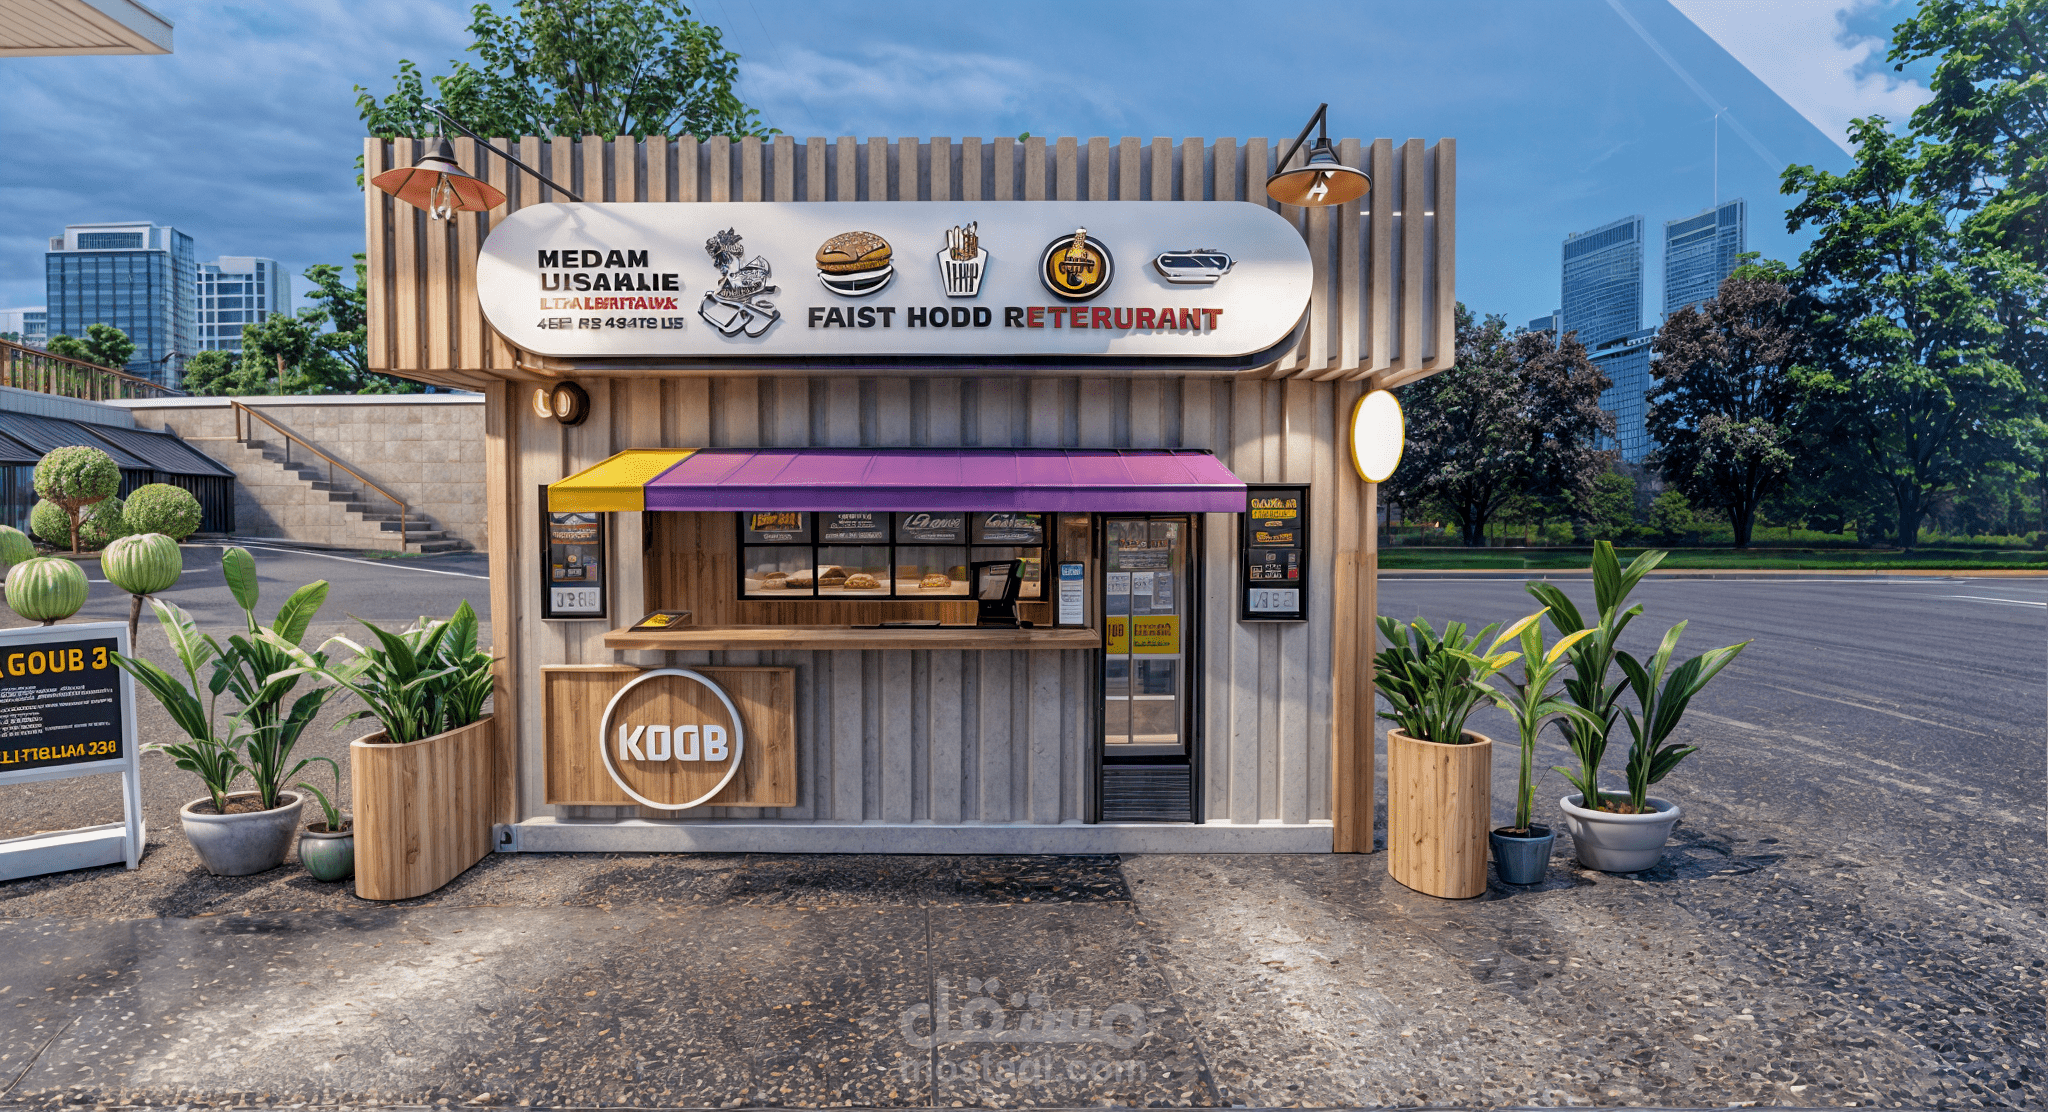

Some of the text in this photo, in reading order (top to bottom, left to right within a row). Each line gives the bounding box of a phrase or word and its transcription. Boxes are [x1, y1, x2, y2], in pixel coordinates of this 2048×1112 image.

[538, 249, 649, 269] MEDAM
[808, 306, 1223, 332] FAIST HODD RETERURANT
[7, 648, 85, 677] GOUB
